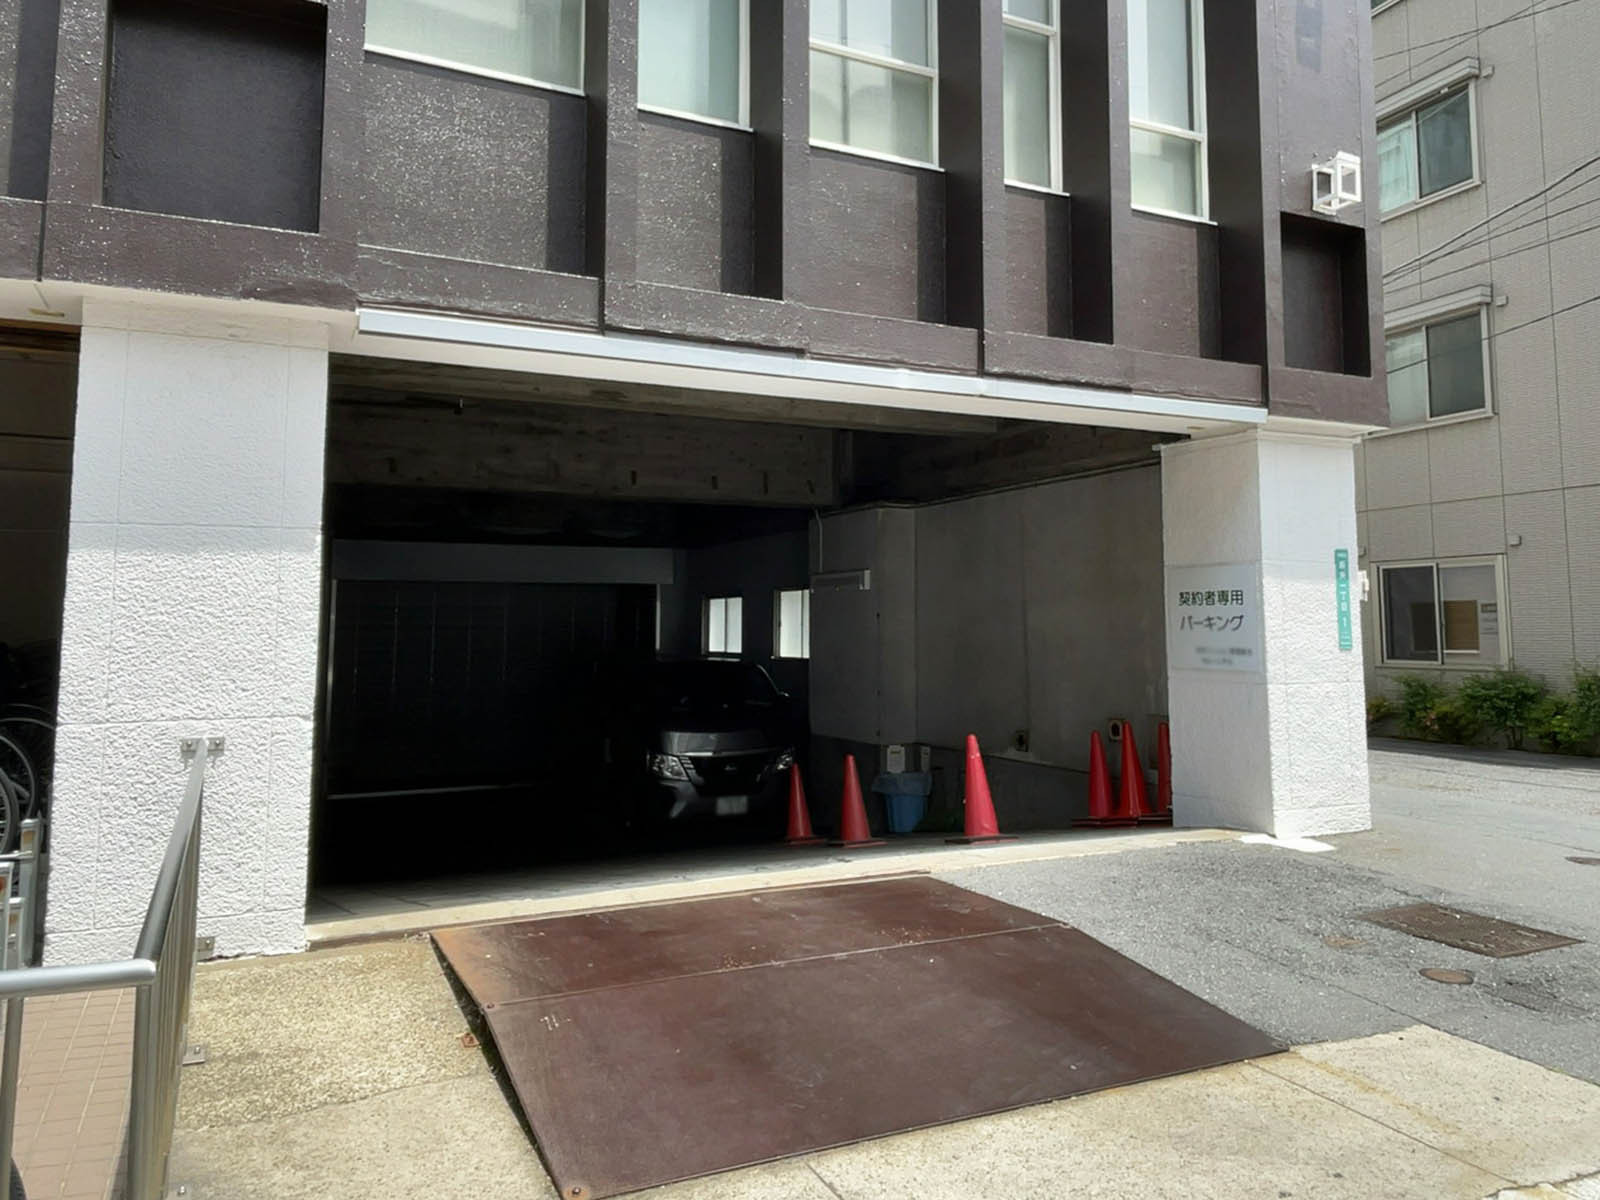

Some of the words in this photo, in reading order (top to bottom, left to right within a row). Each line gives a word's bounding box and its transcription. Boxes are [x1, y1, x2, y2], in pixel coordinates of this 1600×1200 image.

[1178, 590, 1244, 606] 契約者専用
[1180, 614, 1244, 631] パーキング
